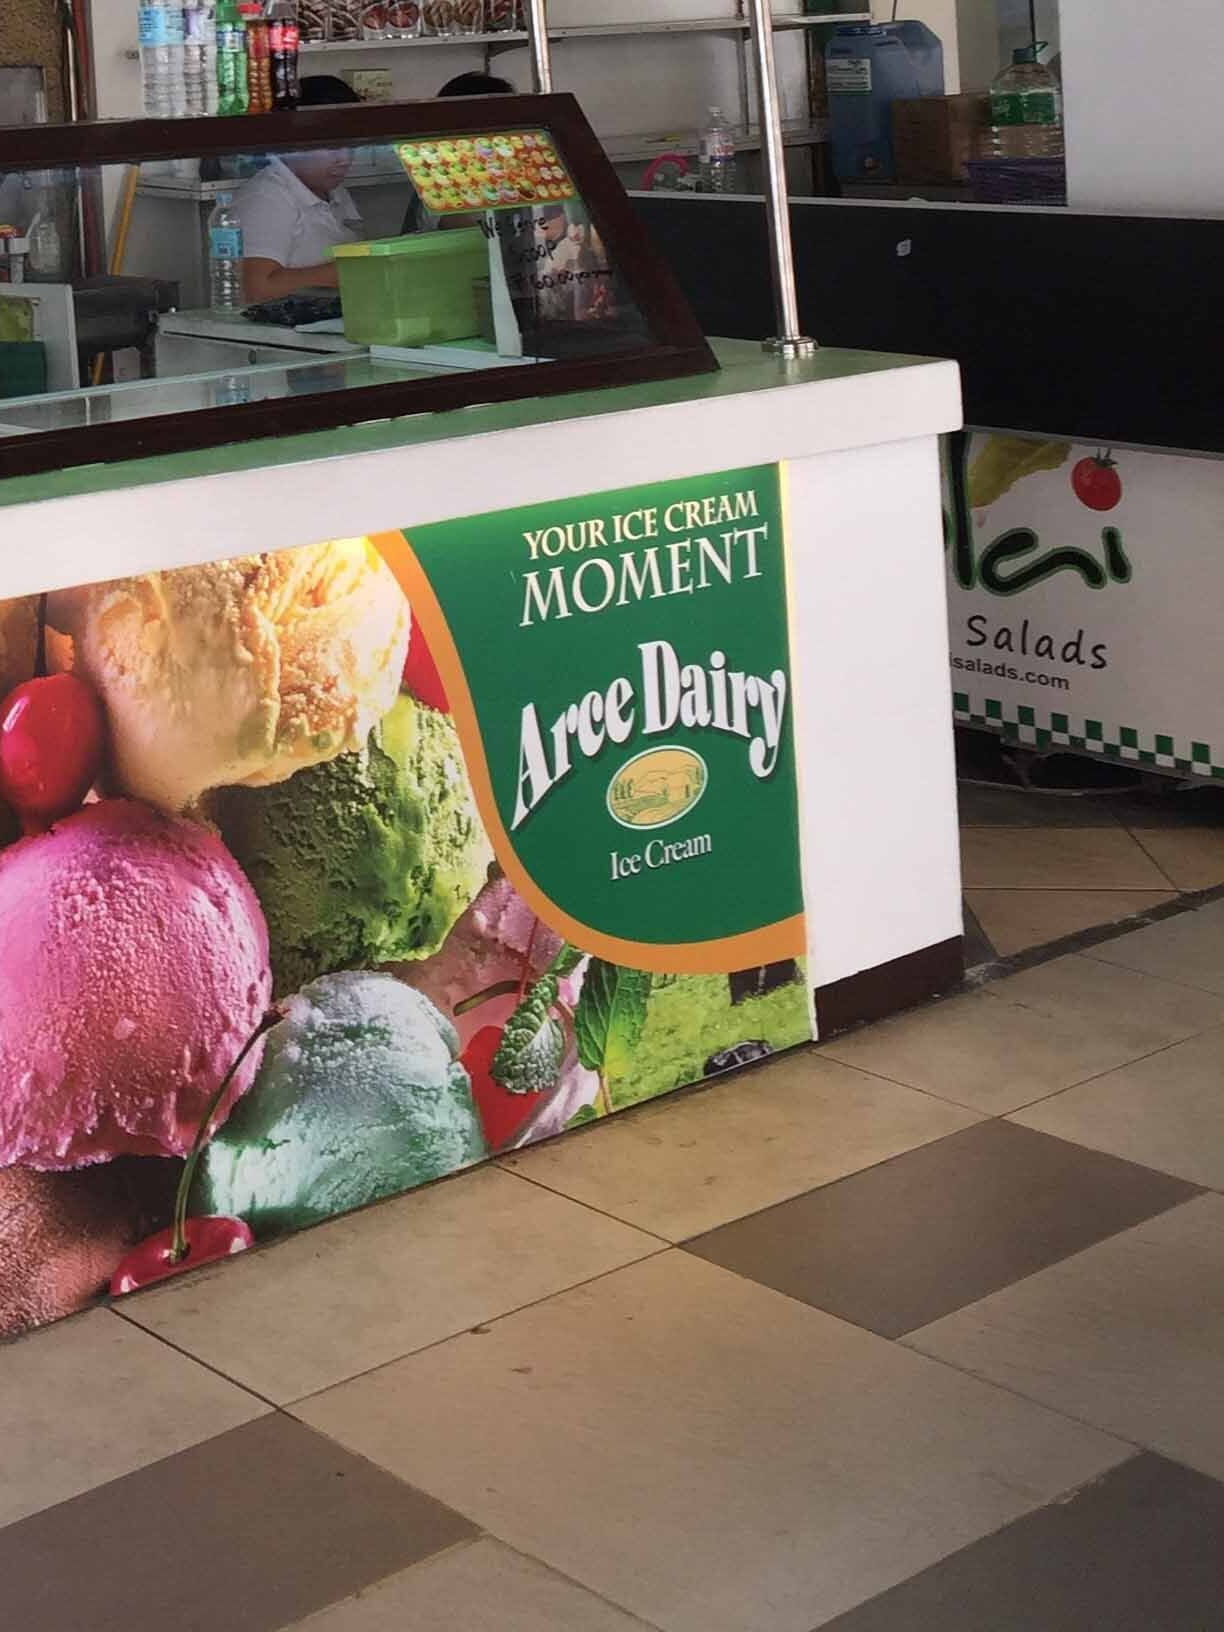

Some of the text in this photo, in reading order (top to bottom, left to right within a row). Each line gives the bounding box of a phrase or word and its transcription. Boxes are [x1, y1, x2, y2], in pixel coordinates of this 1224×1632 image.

[522, 489, 760, 560] YOUR ICE CREAM
[518, 522, 769, 627] MOMENT
[966, 615, 1109, 669] Salads
[510, 640, 787, 831] Arce Dairy
[609, 832, 713, 881] Ice Cream
